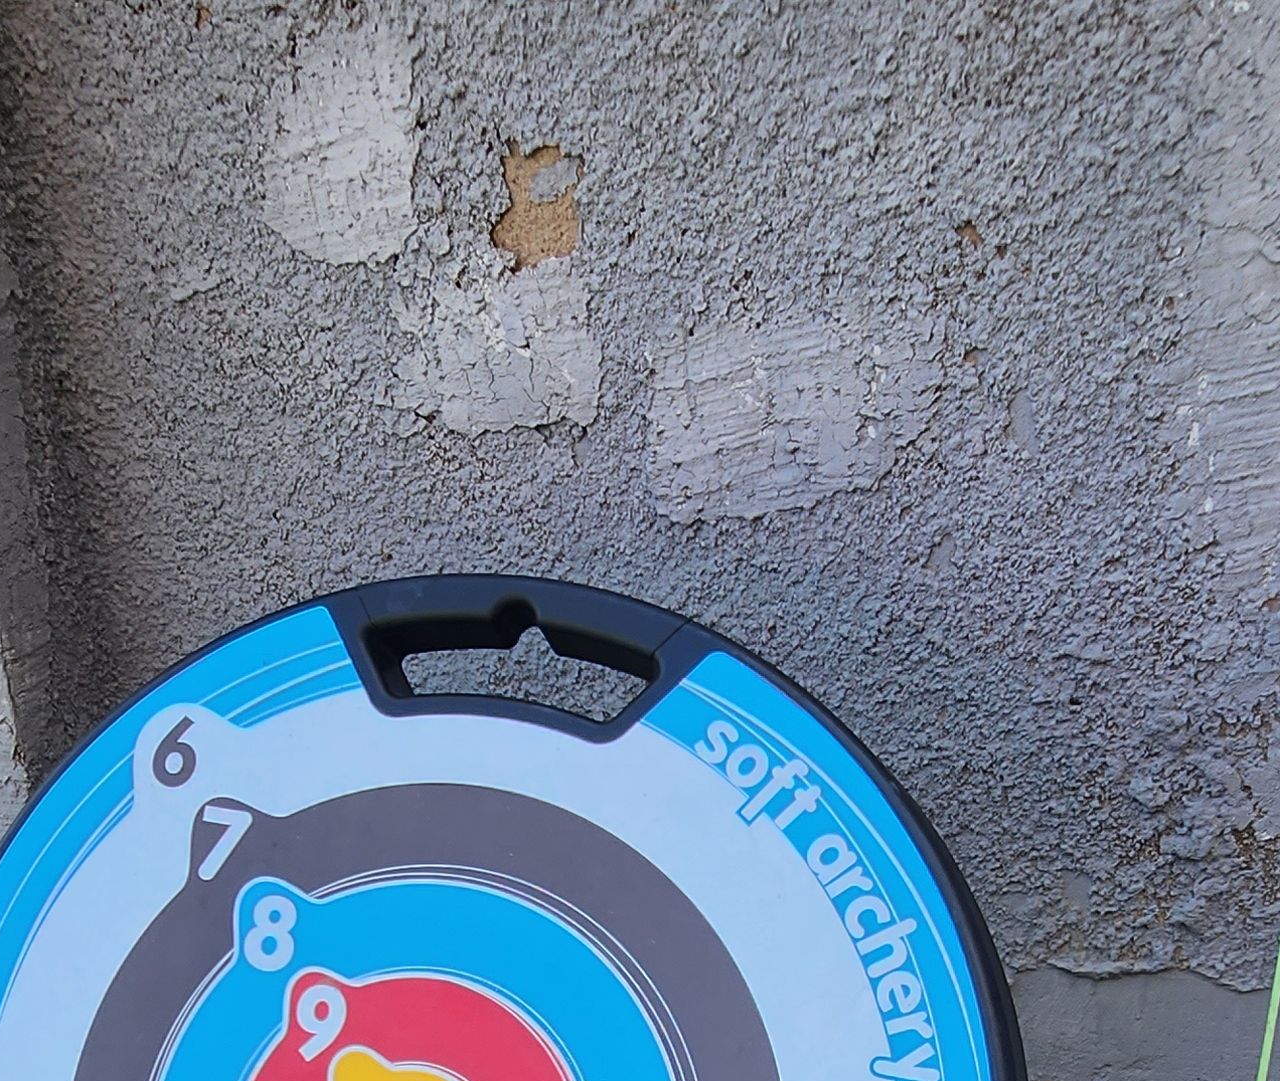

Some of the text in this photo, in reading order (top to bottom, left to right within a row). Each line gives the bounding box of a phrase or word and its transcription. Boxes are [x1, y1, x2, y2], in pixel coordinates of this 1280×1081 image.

[152, 716, 197, 787] 6
[694, 719, 821, 830] soft
[198, 805, 252, 880] 7
[244, 895, 297, 971] 8
[295, 985, 347, 1062] 9
